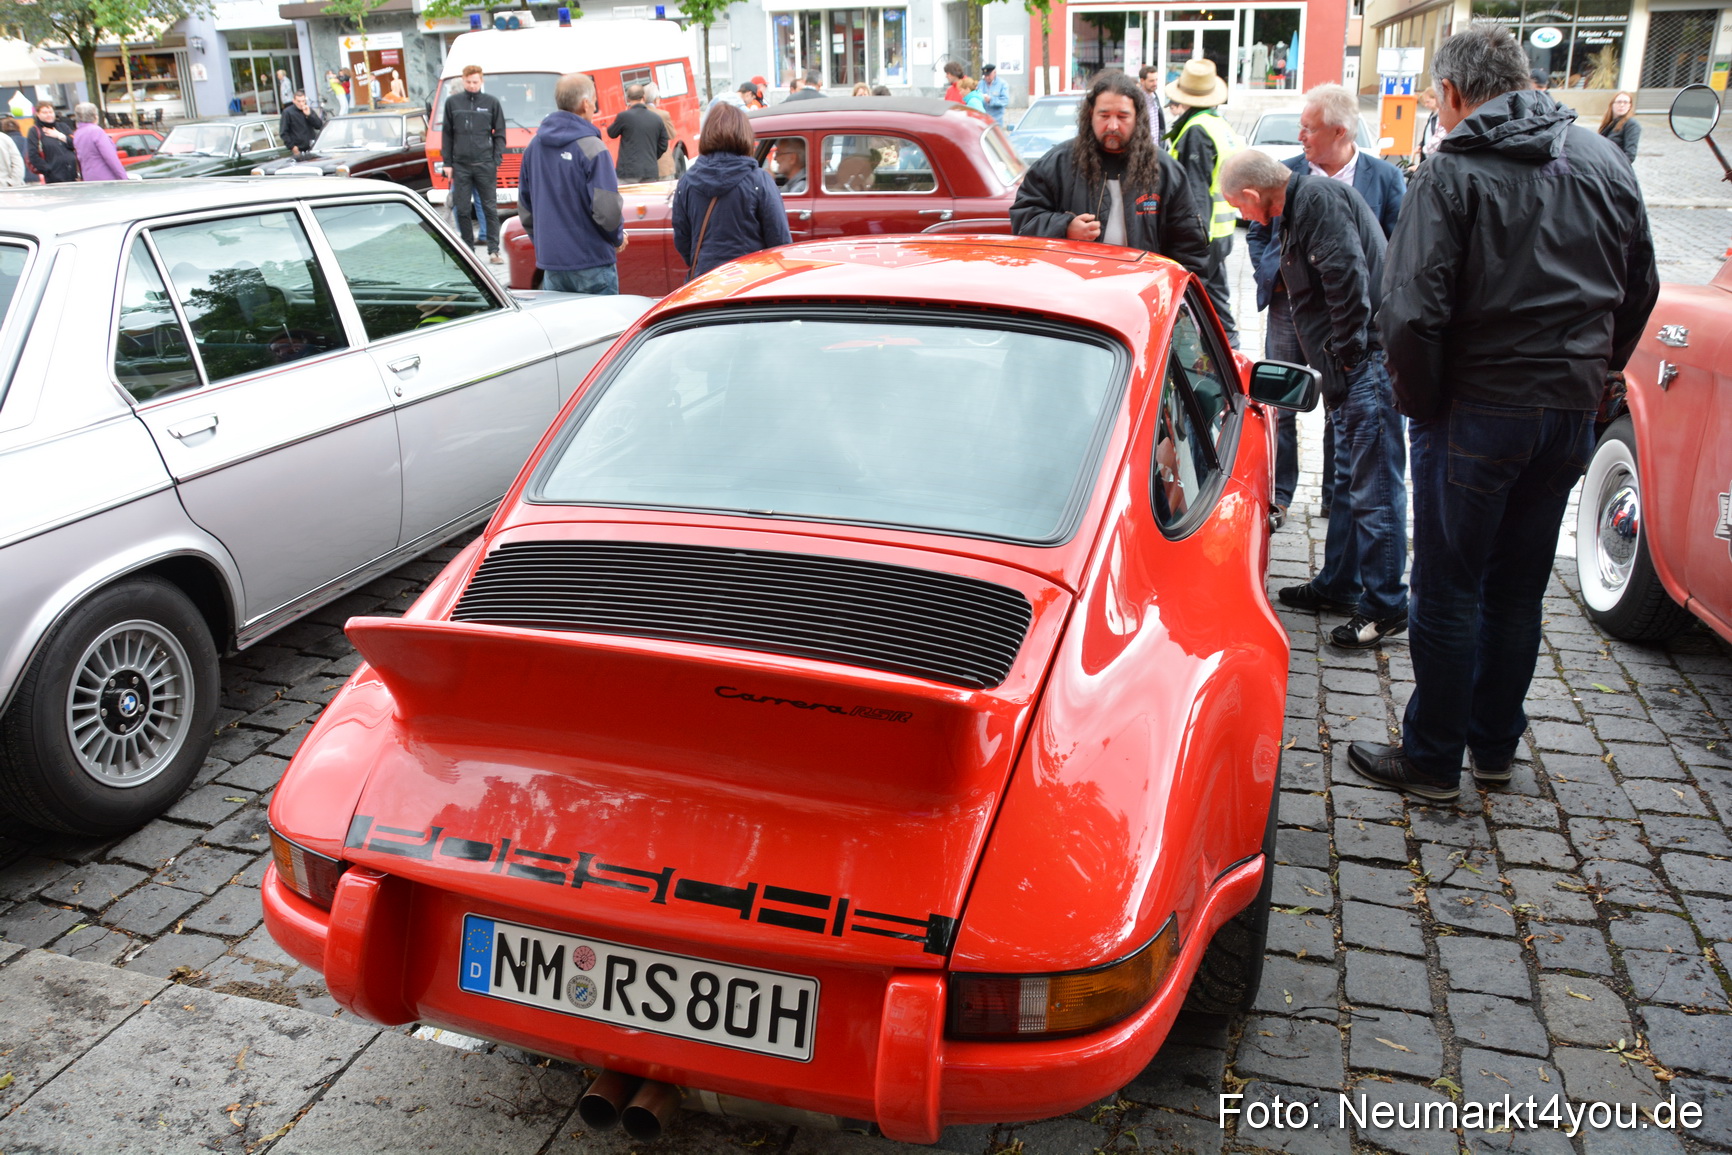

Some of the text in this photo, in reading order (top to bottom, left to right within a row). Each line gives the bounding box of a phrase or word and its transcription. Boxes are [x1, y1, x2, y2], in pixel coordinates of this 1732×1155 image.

[714, 685, 913, 724] Carrera RSR
[469, 962, 482, 979] D
[494, 932, 566, 1001] NM
